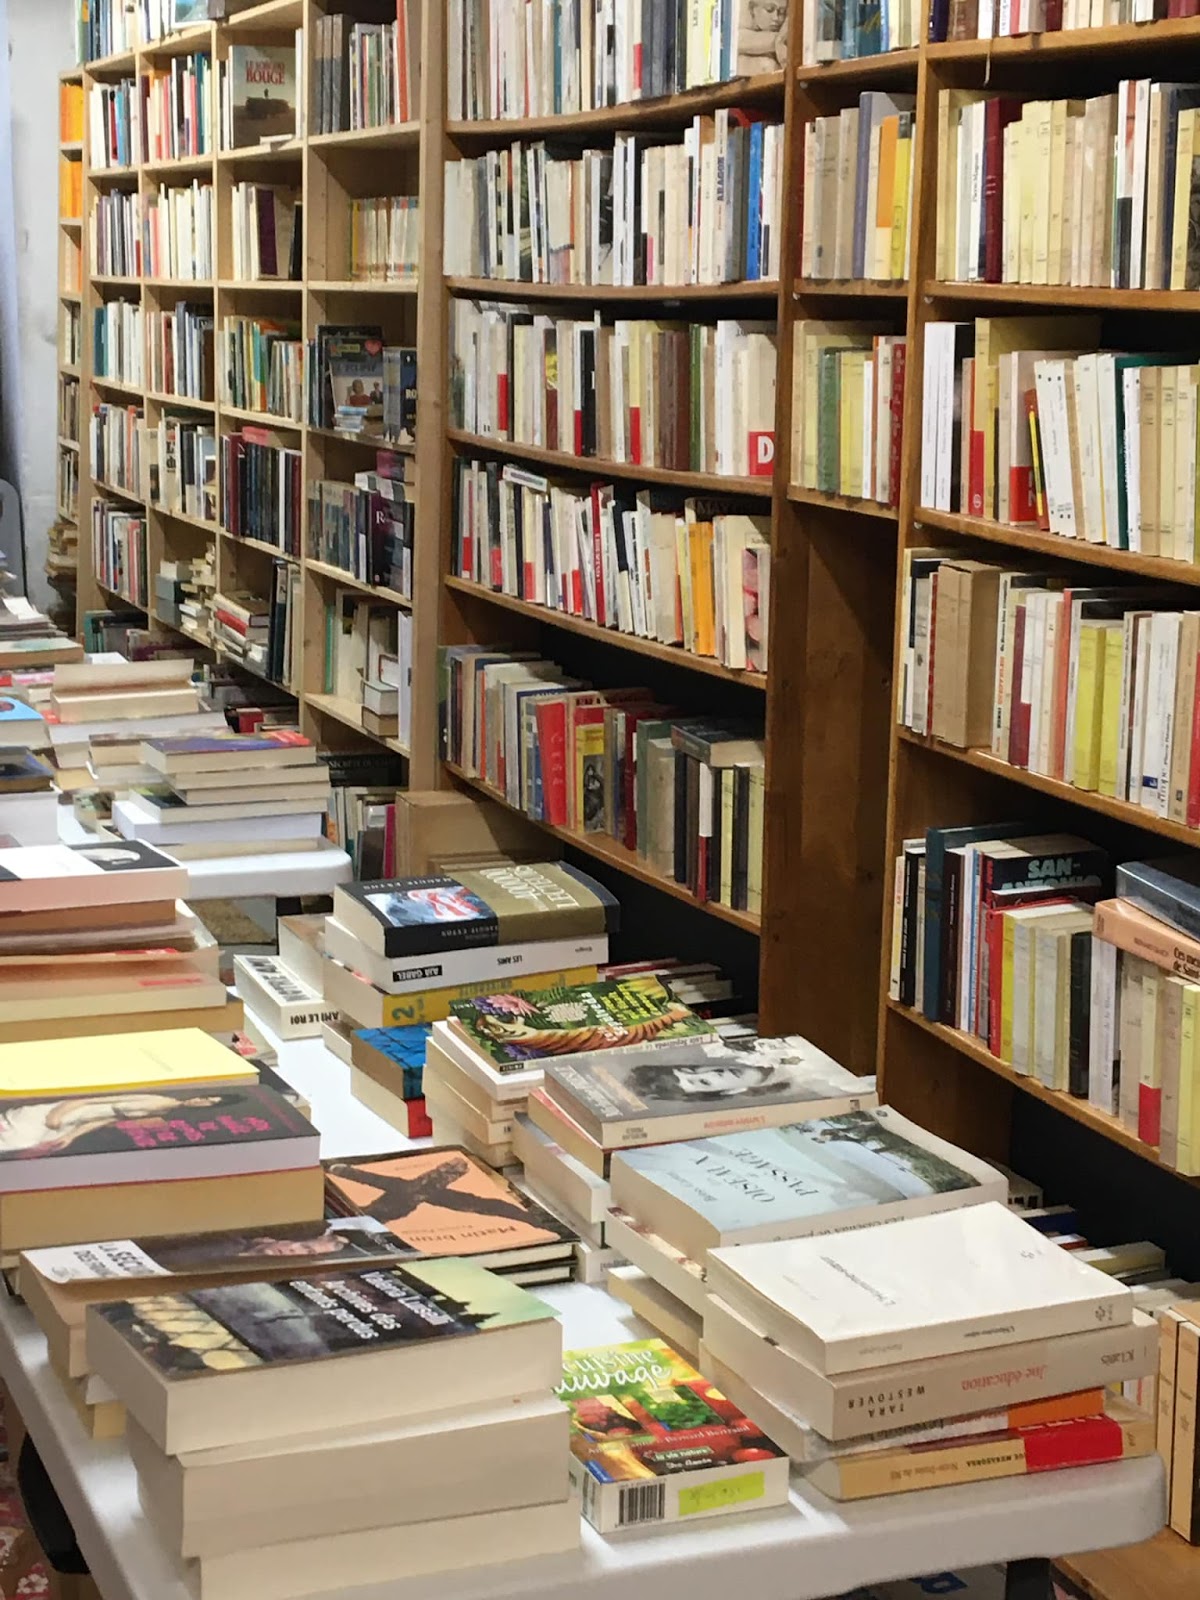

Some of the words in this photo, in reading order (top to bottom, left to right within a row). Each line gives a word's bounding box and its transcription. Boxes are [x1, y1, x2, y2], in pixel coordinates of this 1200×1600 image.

[246, 68, 286, 85] ROUGE
[716, 156, 725, 202] ARAGON
[757, 435, 774, 464] D
[497, 956, 512, 966] AMIS
[511, 955, 523, 964] LES
[396, 969, 424, 981] GABEL
[424, 966, 440, 977] AJA
[290, 1014, 307, 1026] ROI
[308, 1013, 320, 1023] LE
[320, 1010, 340, 1022] AMI
[694, 1154, 776, 1204] OISEAUX
[728, 1147, 820, 1197] PASSAGE
[409, 1232, 457, 1244] brun
[459, 1225, 519, 1240] Matin
[321, 1279, 379, 1314] Archives
[369, 1312, 402, 1331] des
[360, 1270, 407, 1298] Valeria
[398, 1294, 455, 1326] Luiselli
[289, 1280, 339, 1309] enfants
[323, 1307, 380, 1340] perdus
[960, 1367, 1028, 1392] éducation
[847, 1385, 926, 1411] WESTOVER
[868, 1403, 905, 1420] TARA
